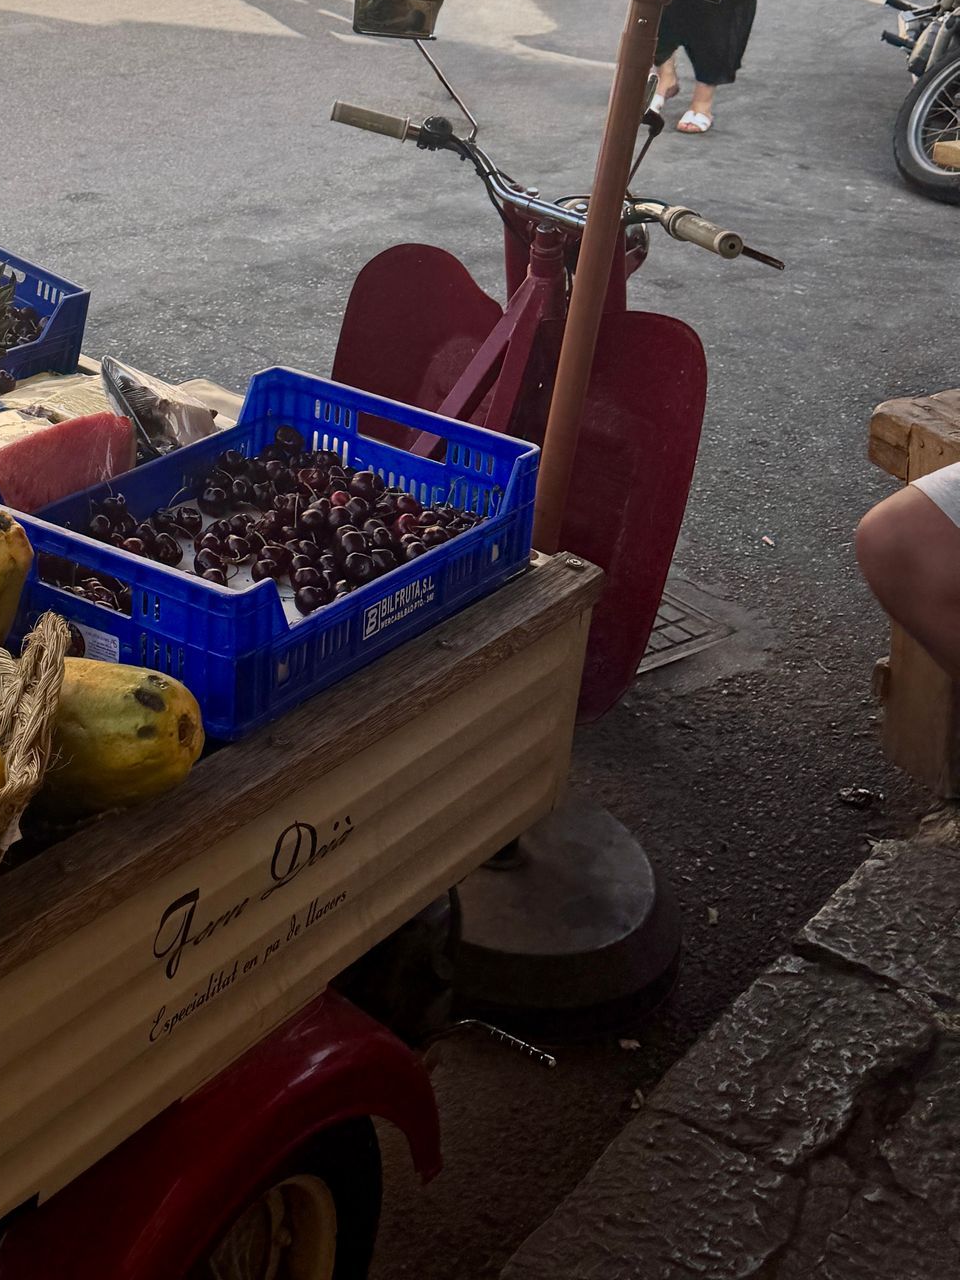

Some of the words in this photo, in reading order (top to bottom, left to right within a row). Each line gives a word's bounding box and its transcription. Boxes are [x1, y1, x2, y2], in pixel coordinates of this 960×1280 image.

[149, 960, 239, 1042] Especialitat
[243, 955, 258, 974] en
[263, 939, 281, 965] pa
[286, 914, 301, 941] de
[305, 891, 347, 928] llavors
